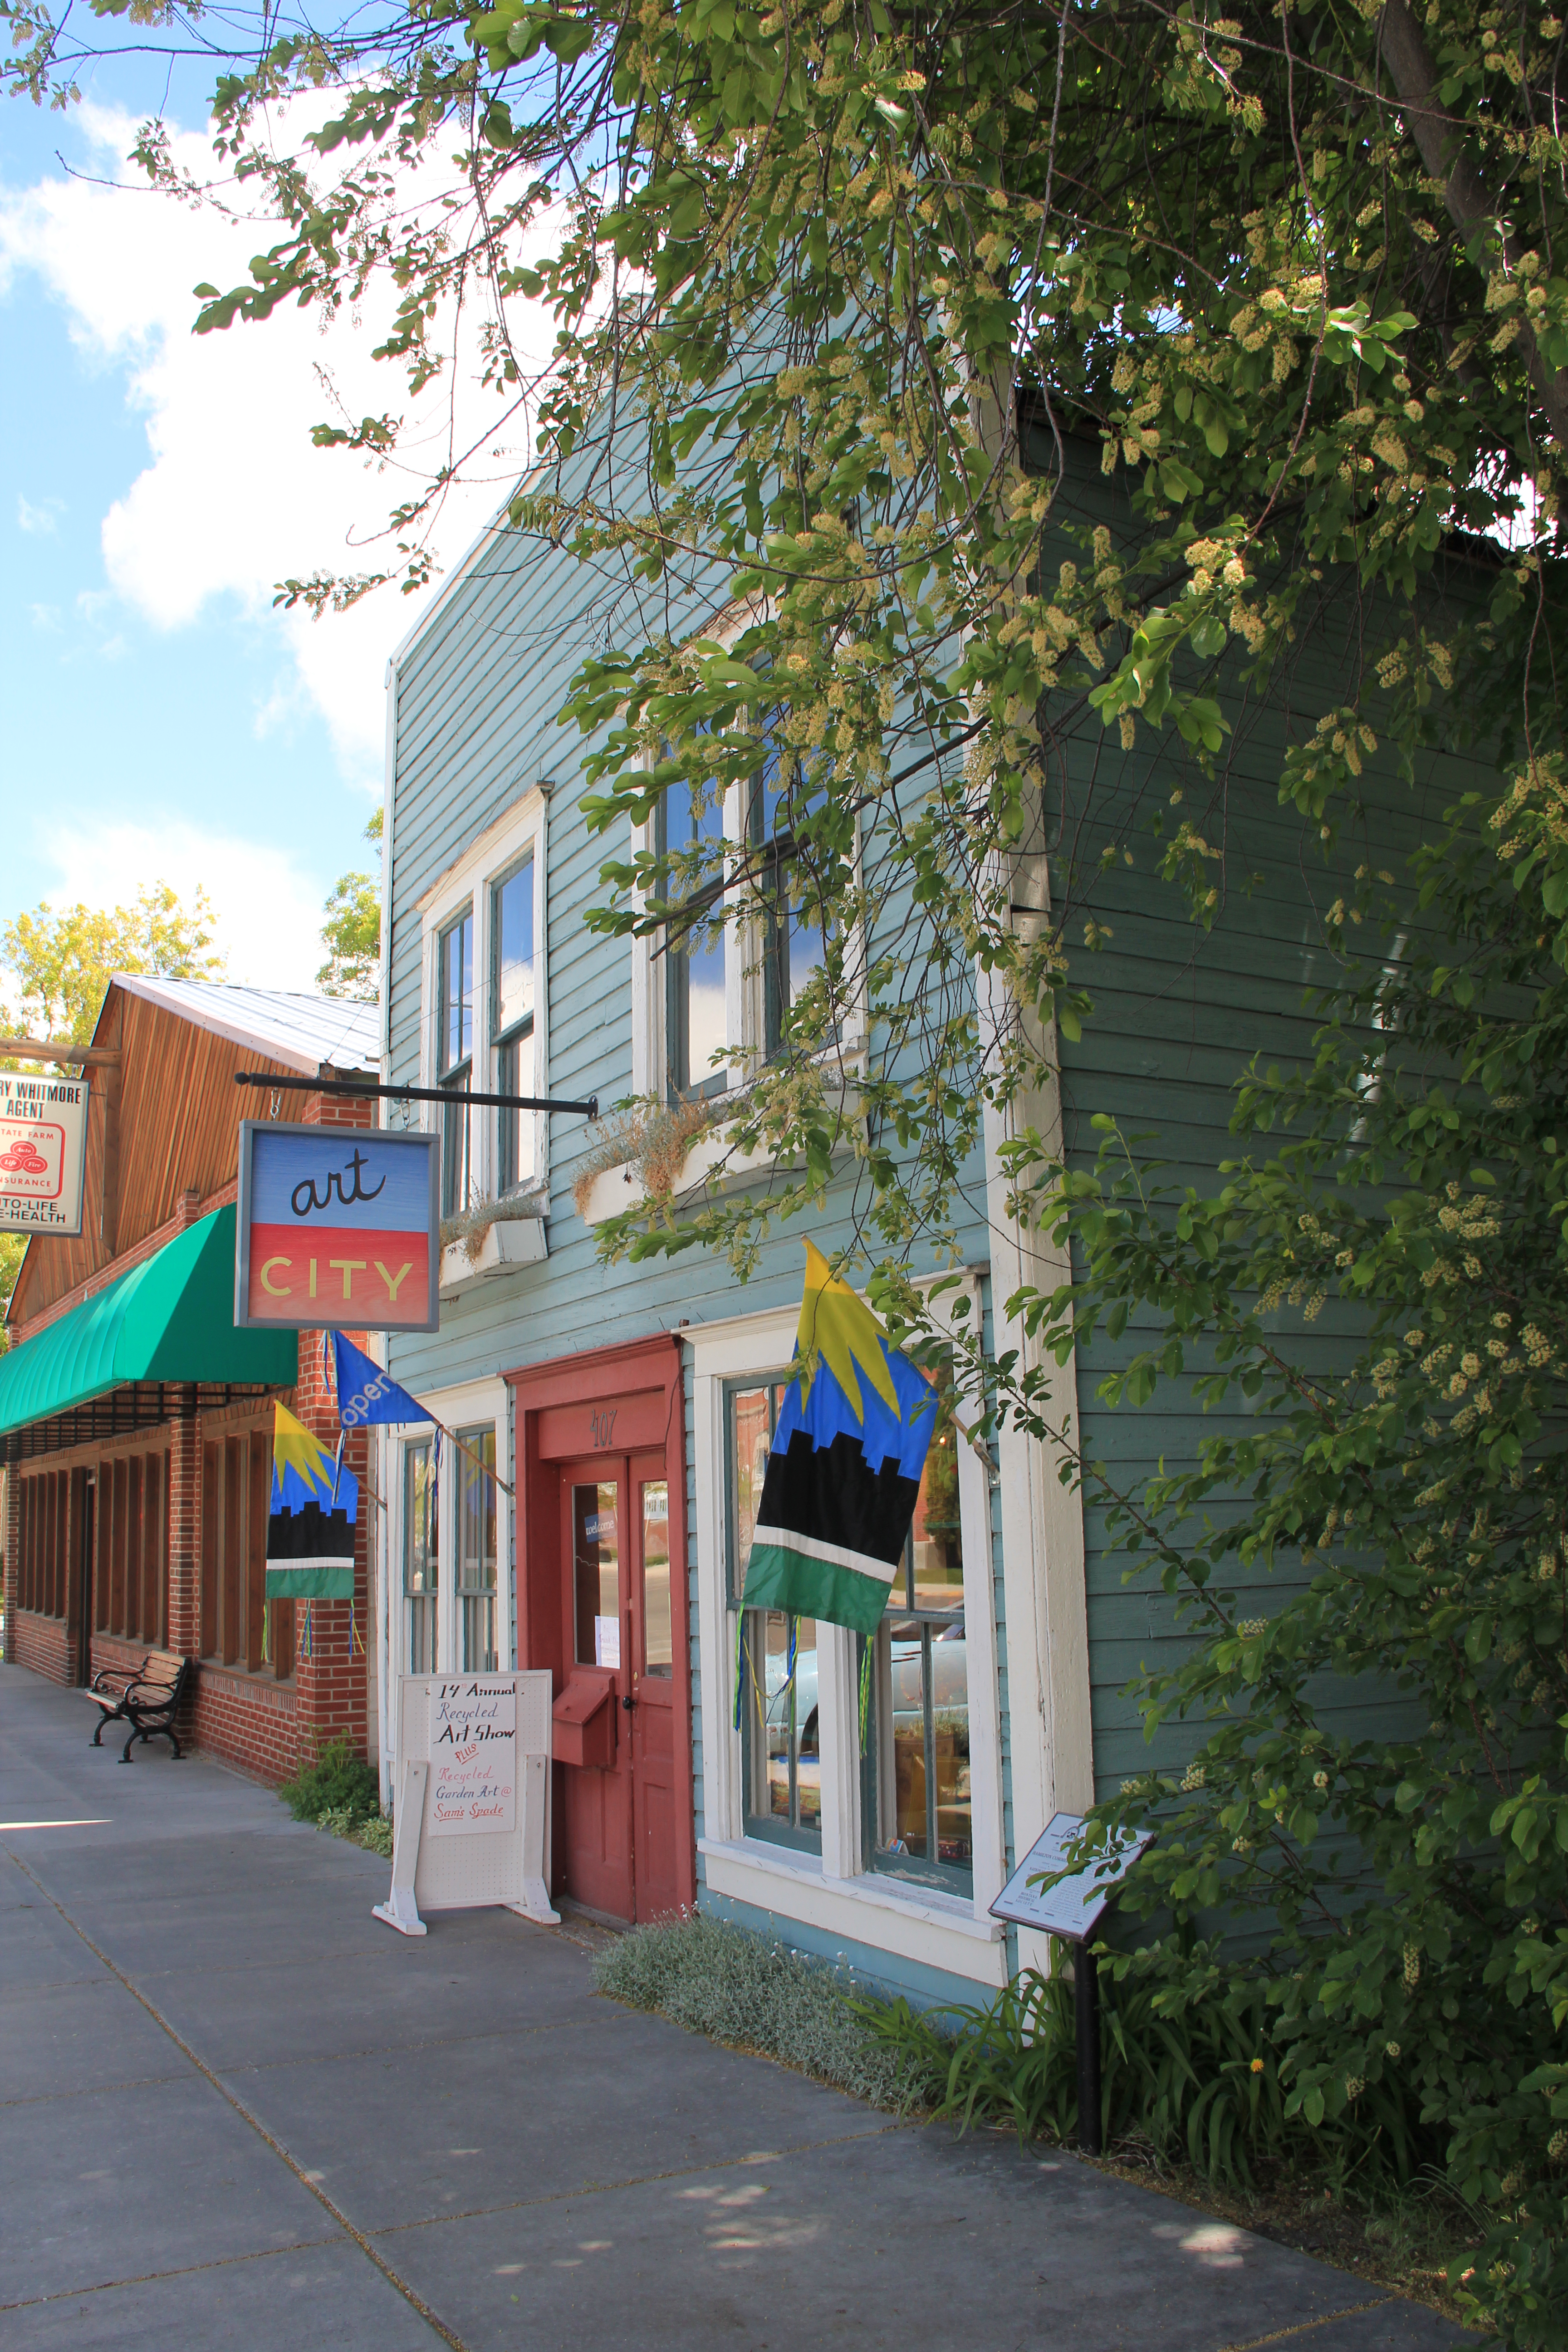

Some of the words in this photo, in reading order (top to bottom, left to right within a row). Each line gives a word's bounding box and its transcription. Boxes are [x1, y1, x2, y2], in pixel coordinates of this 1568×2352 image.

[17, 1082, 81, 1104] WHITMORE
[6, 1099, 45, 1119] AGENT
[291, 1147, 386, 1216] art
[0, 1198, 58, 1212] TO-LIFE
[260, 1256, 414, 1301] CITY
[341, 1372, 397, 1426] open
[590, 1408, 617, 1448] 407
[586, 1520, 614, 1536] welcome
[466, 1681, 515, 1697] Annual
[436, 1702, 499, 1724] Recycled
[432, 1724, 471, 1744] Art
[473, 1724, 516, 1741] Show
[455, 1743, 477, 1763] PLUS
[438, 1765, 495, 1784] Recycled
[436, 1785, 475, 1799] Garden
[477, 1785, 500, 1798] Art
[434, 1803, 465, 1819] Sam's
[469, 1802, 504, 1819] Spade
